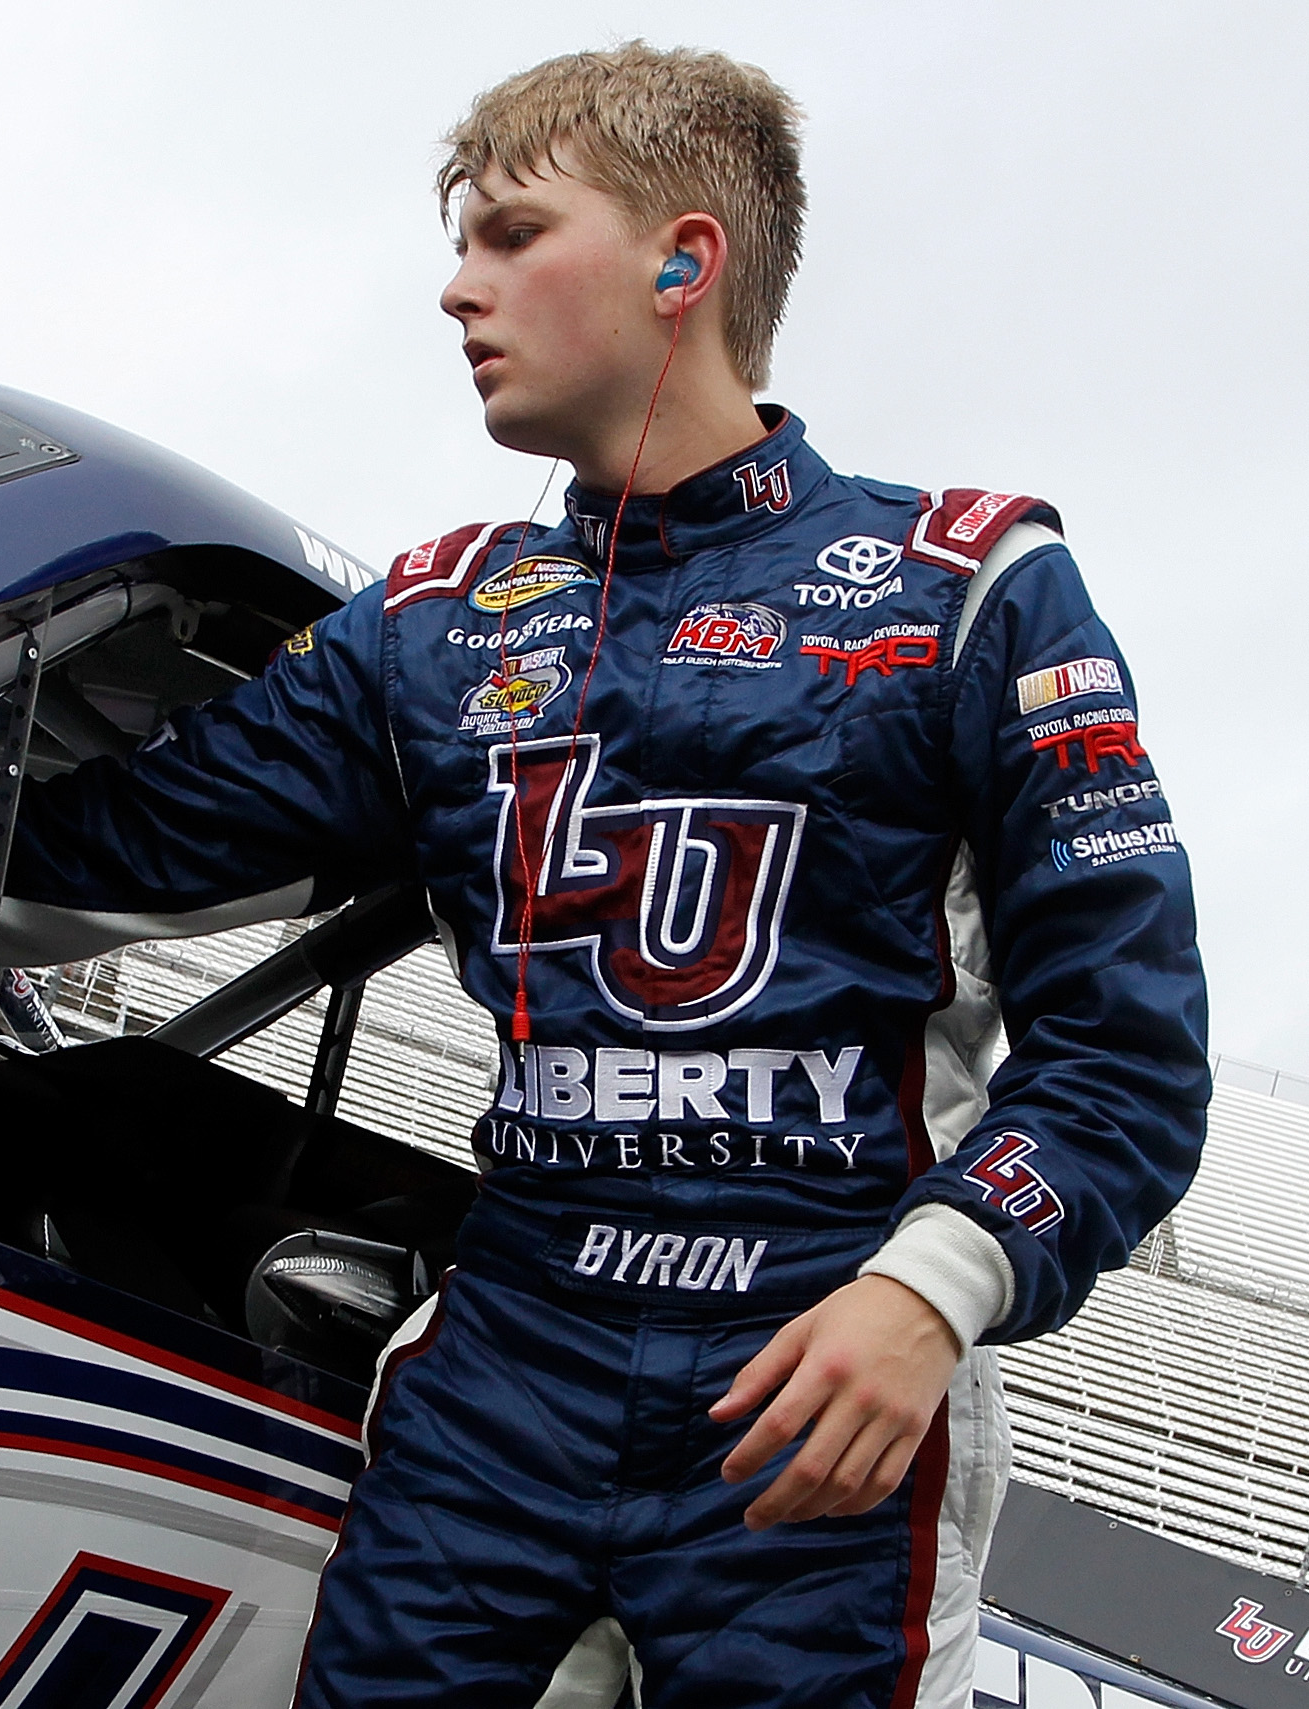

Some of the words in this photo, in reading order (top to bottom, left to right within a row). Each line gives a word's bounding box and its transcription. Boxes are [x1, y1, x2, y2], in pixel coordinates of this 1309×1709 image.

[732, 459, 793, 514] LU
[484, 572, 538, 593] CAMPING
[538, 572, 586, 583] WORLD
[793, 577, 905, 611] TOYOTA
[446, 610, 595, 651] GOODYEAR
[666, 614, 780, 659] KBM
[800, 634, 840, 650] TOYOTA
[843, 633, 874, 651] RACIN
[873, 623, 941, 641] DEVELOPMENT
[519, 649, 560, 673] NASCAR
[798, 635, 939, 687] TRD
[461, 712, 502, 728] ROOKIE
[1028, 715, 1072, 741] TOYOTA
[1073, 708, 1111, 728] RACING
[1091, 845, 1149, 868] SATELLITE
[487, 732, 808, 1033] LU
[498, 1044, 865, 1124] LIBERTY
[490, 1119, 866, 1170] UNIVERSITY
[573, 1224, 769, 1293] BYRON
[1215, 1595, 1295, 1665] LU
